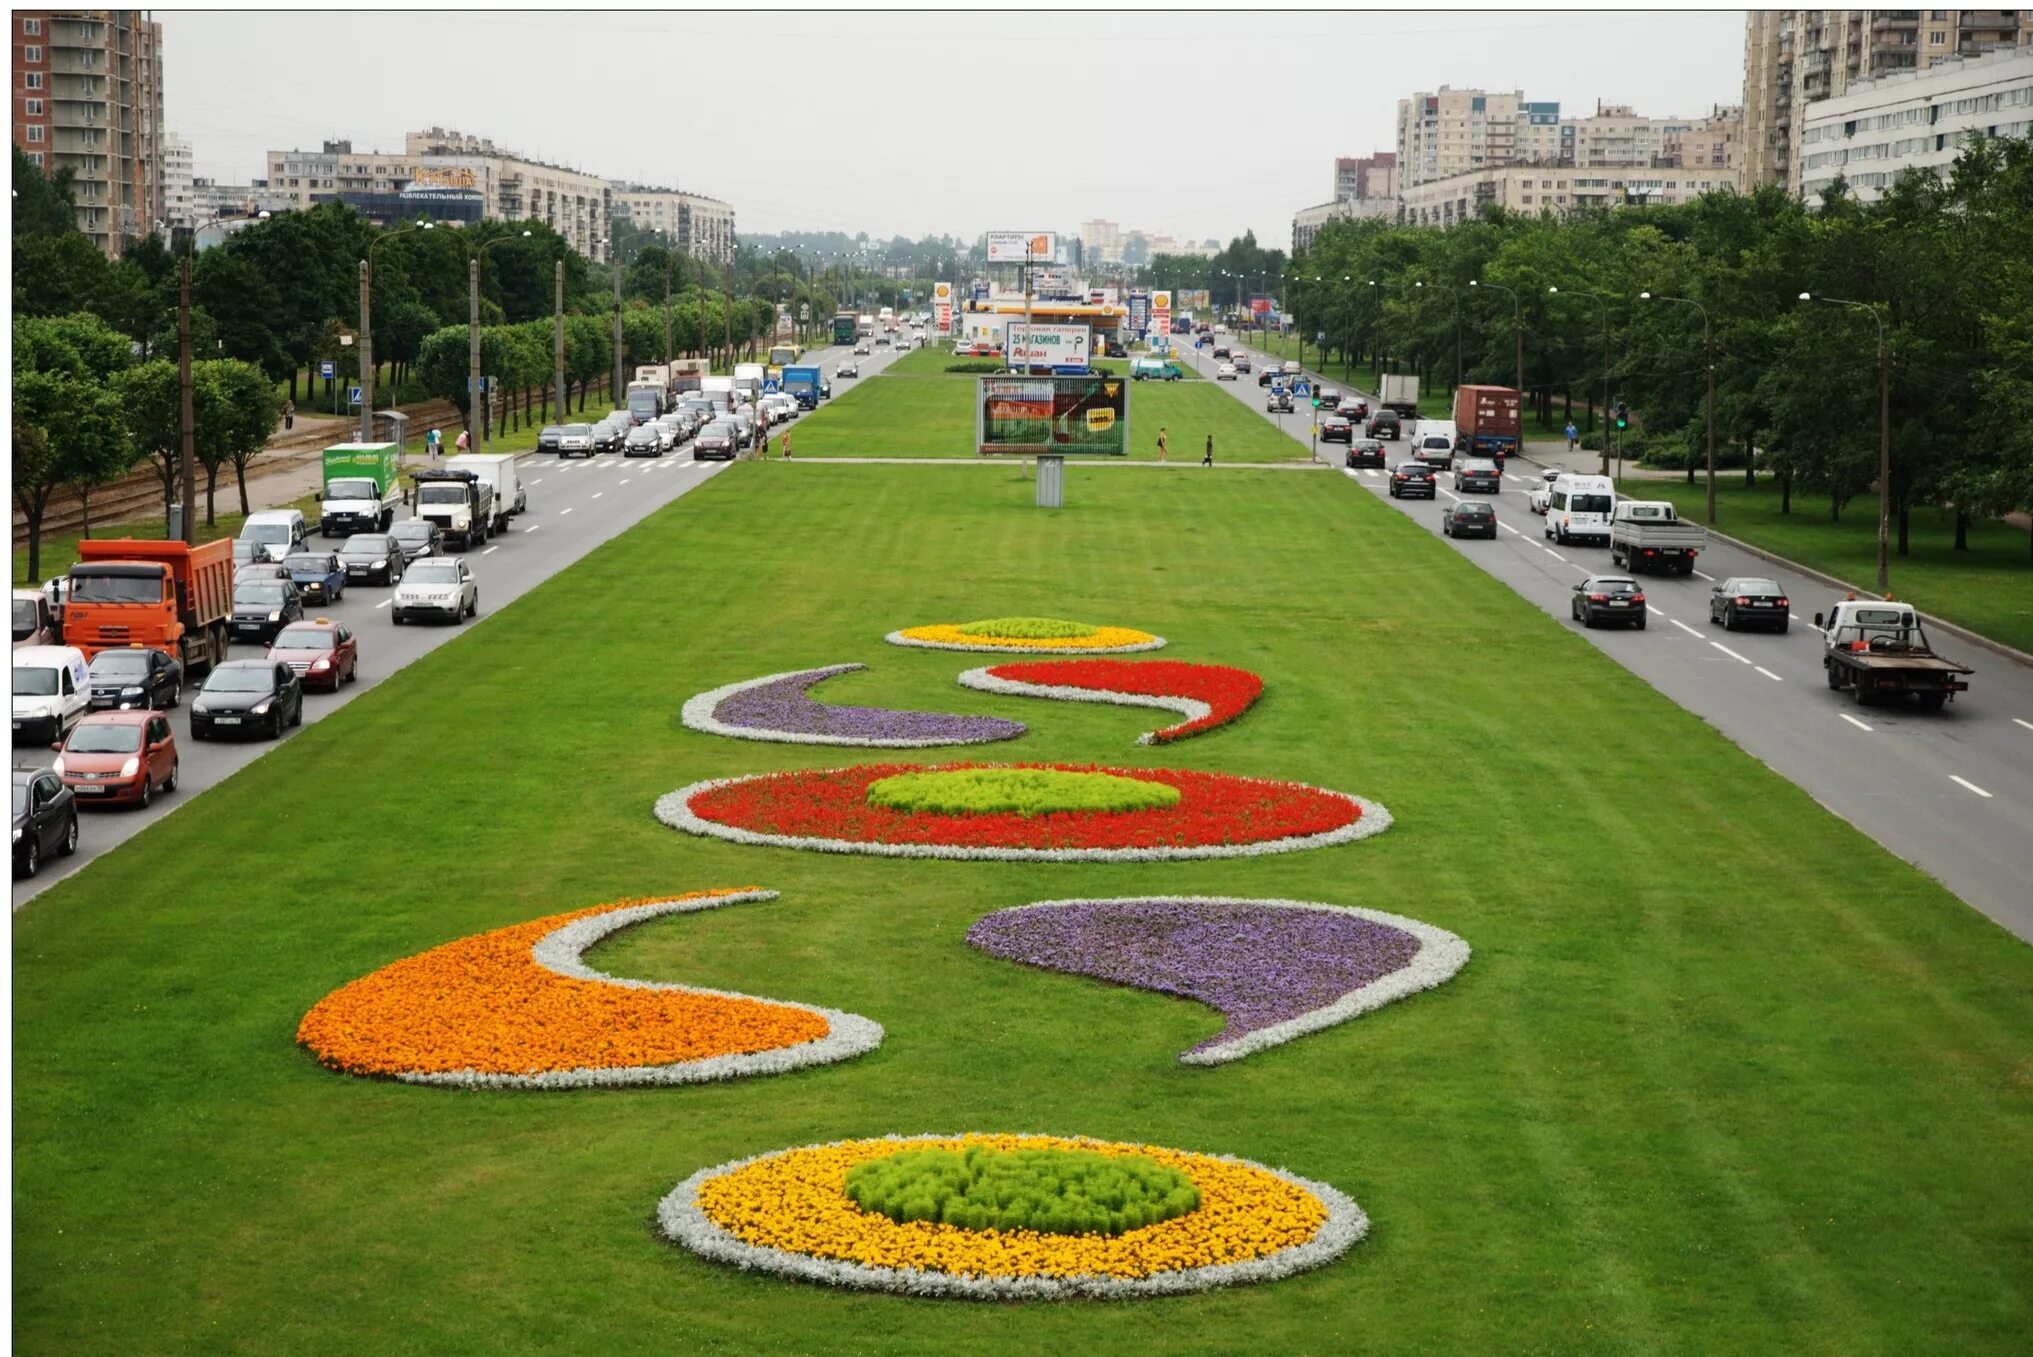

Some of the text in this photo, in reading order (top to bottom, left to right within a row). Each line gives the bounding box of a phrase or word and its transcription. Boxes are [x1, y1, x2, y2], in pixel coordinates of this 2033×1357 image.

[400, 192, 463, 200] РАЗВЛЕКАТЕЛЬНЫЙ
[1013, 325, 1051, 333] Торовая
[1013, 334, 1020, 344] 25
